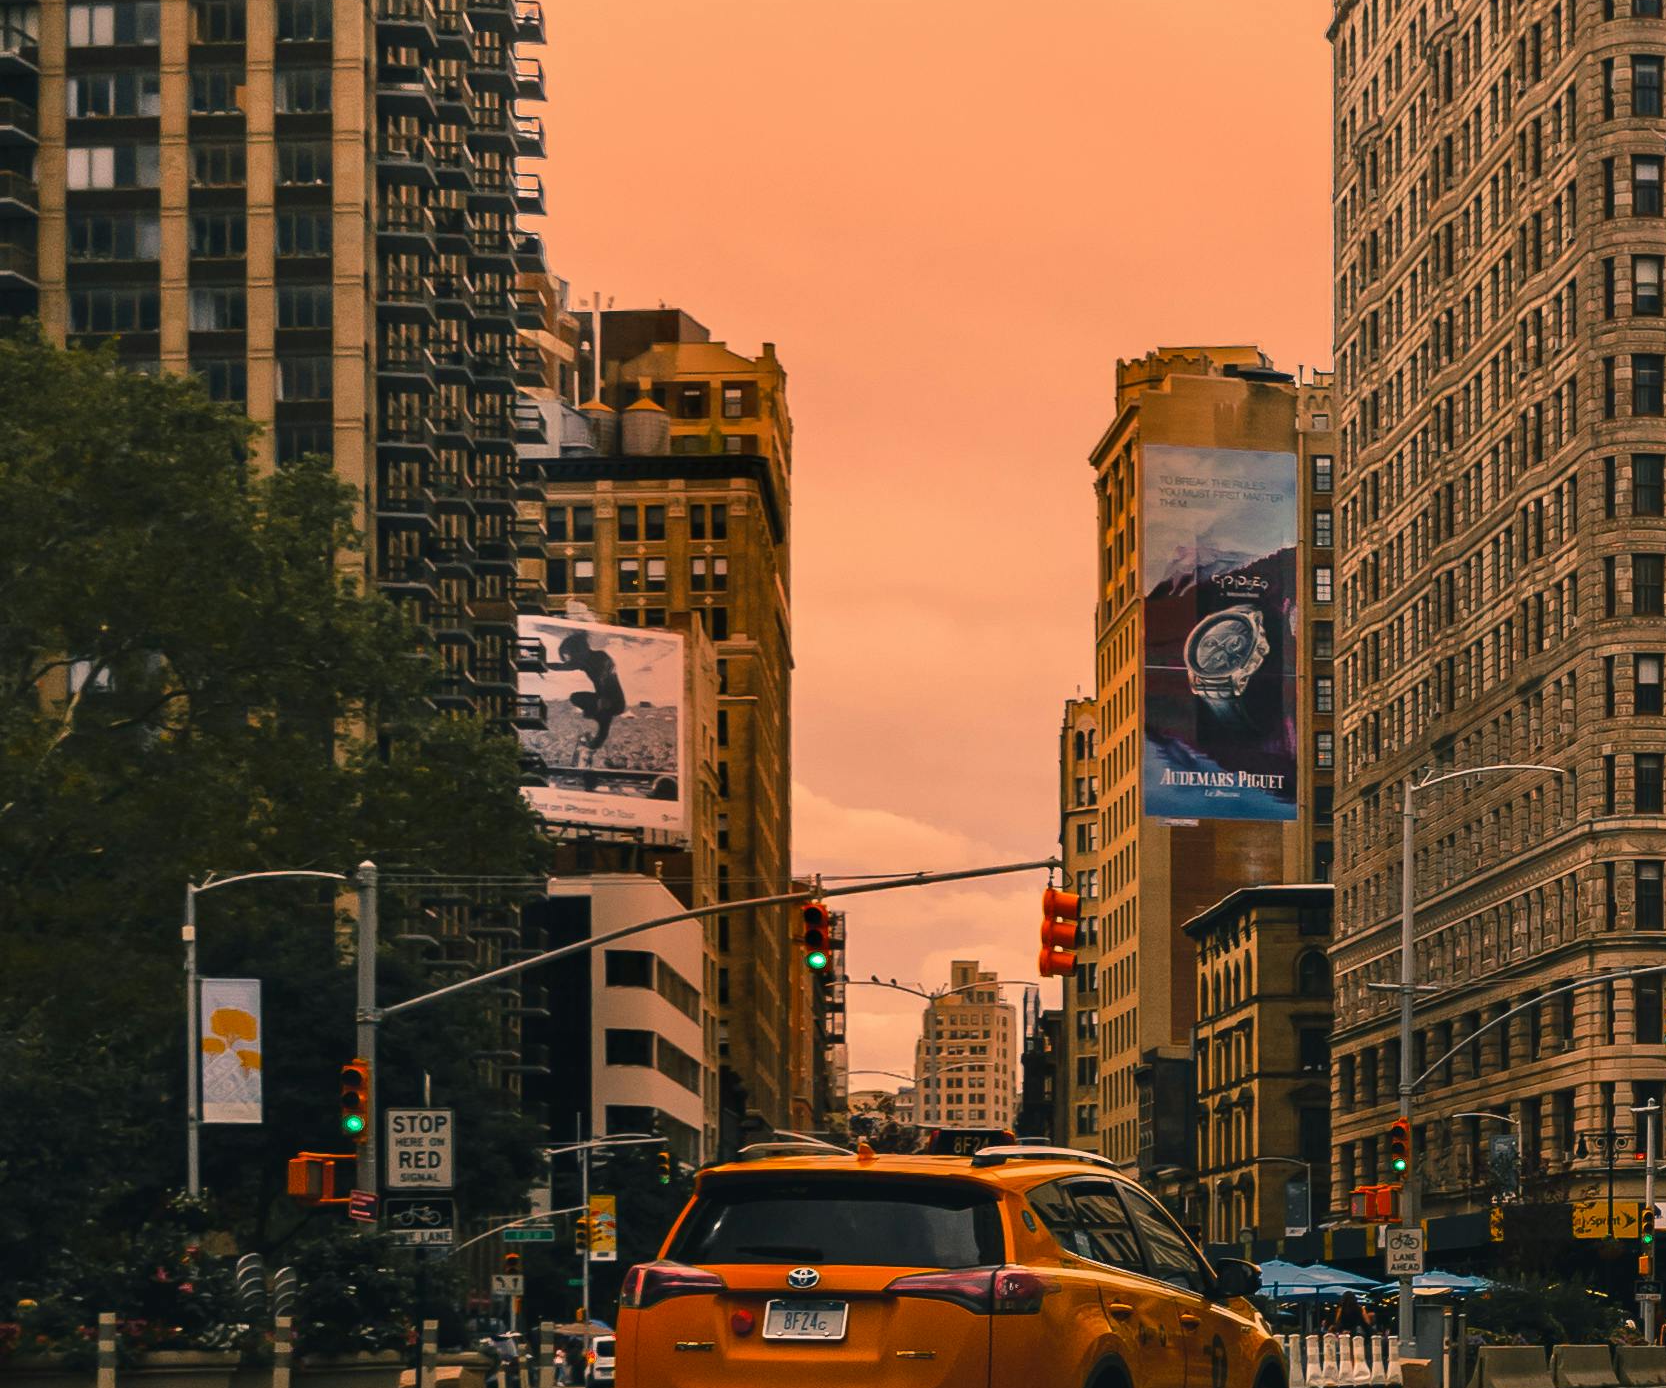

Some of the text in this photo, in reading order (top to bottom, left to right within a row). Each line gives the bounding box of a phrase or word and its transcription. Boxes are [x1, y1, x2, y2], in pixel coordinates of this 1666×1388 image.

[1160, 475, 1266, 490] TO BREAK THE RULES
[1160, 487, 1284, 503] YOU MUST FIRST MASTER
[565, 803, 597, 815] iPhone
[393, 1115, 447, 1133] STOP
[396, 1137, 445, 1147] HERE ON
[953, 1136, 990, 1153] 8F24
[399, 1151, 441, 1169] RED
[400, 1173, 440, 1182] SIGNAL
[1393, 1253, 1417, 1262] LANE
[1391, 1263, 1420, 1271] AHEAD
